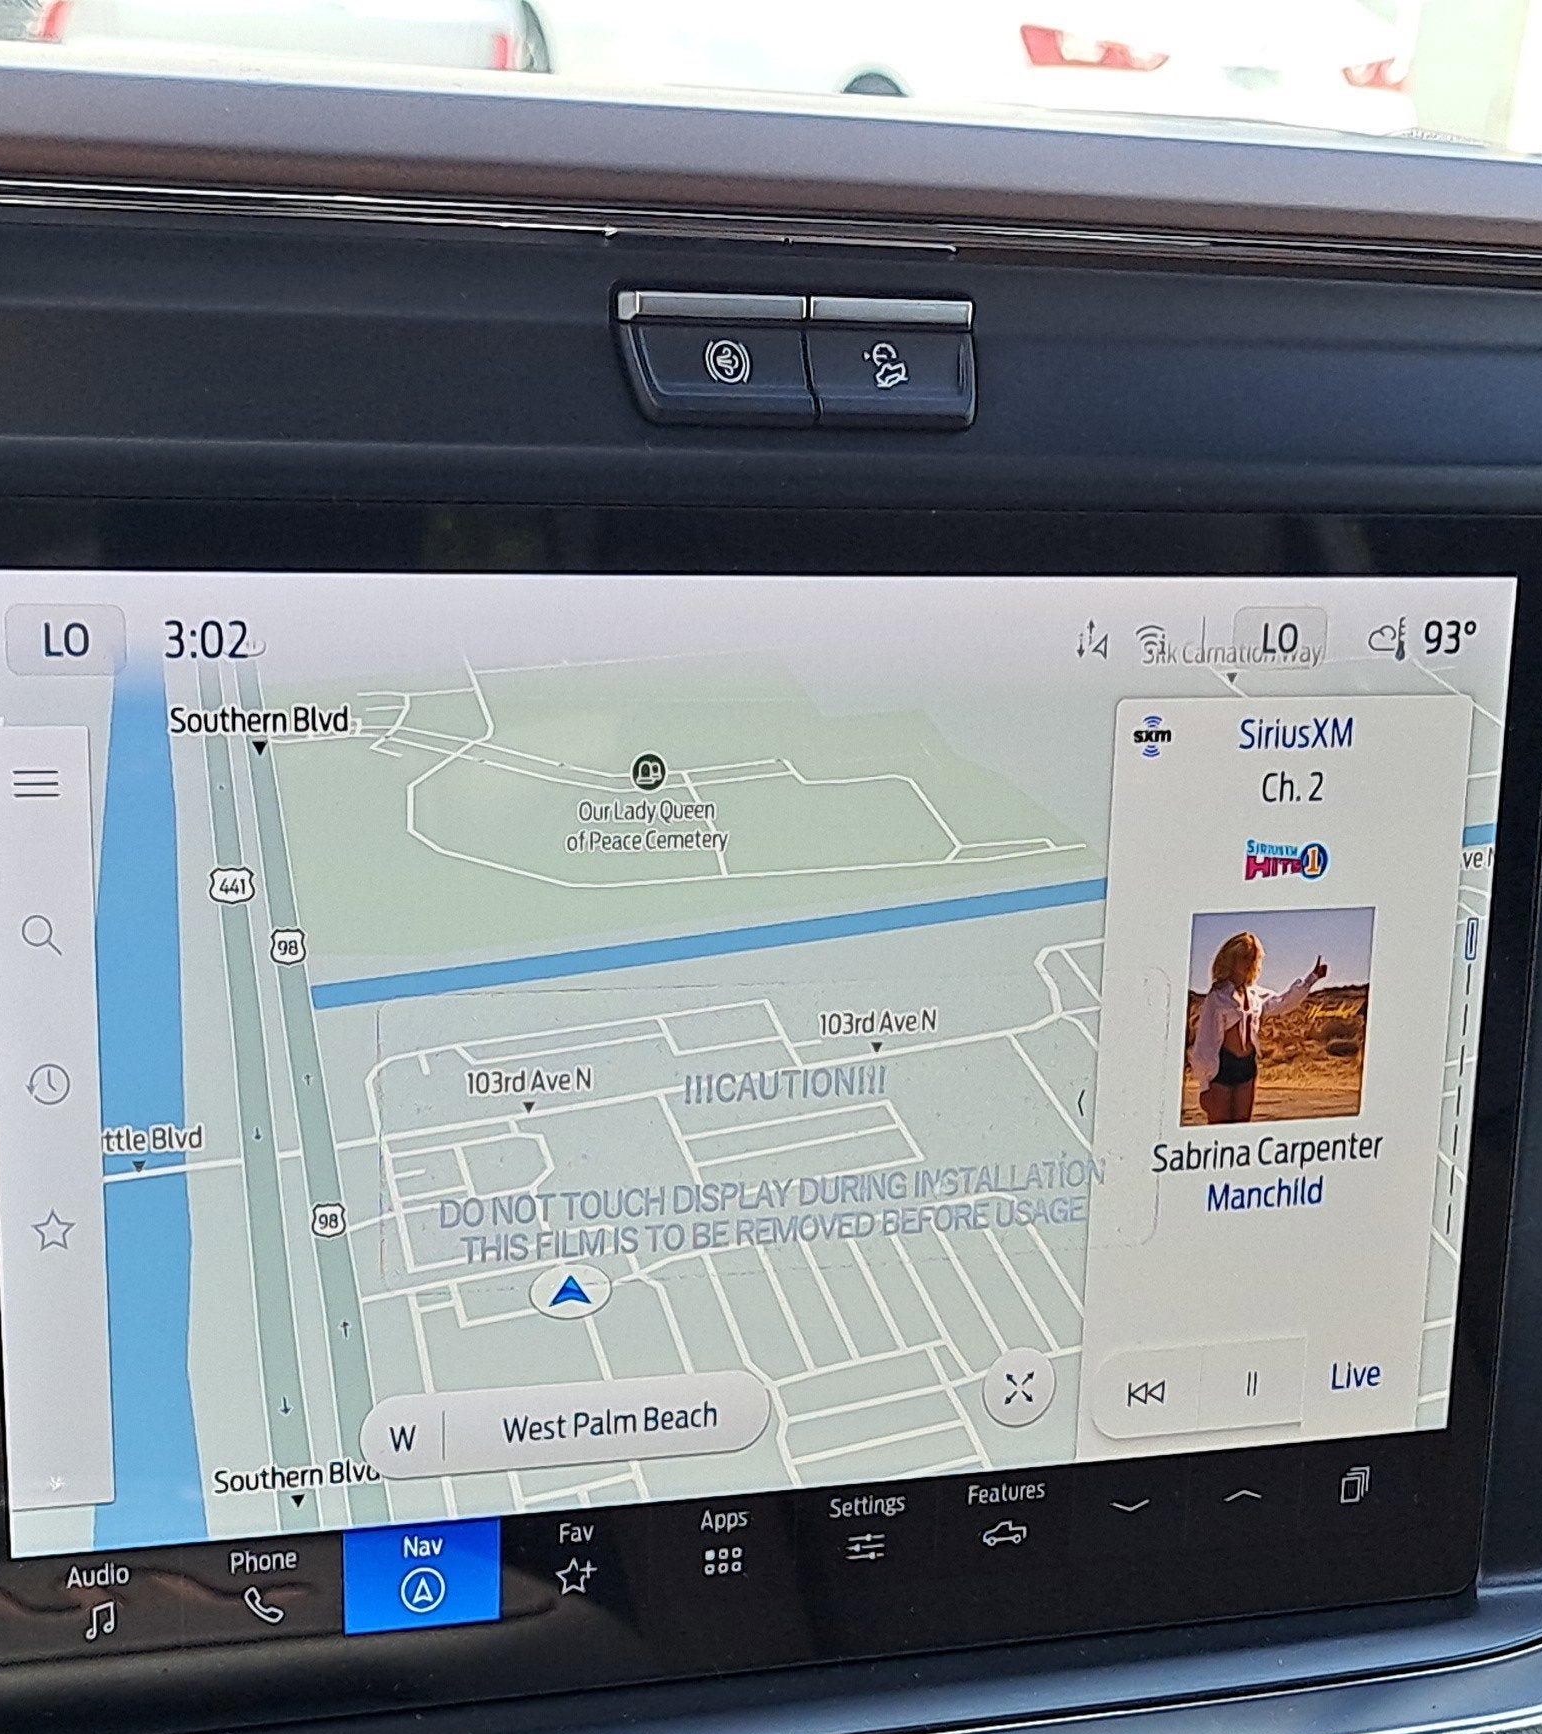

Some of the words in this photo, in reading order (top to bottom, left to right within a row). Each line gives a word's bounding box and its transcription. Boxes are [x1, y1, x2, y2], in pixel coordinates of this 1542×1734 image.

[43, 622, 90, 658] LO
[164, 620, 249, 659] 3:02
[1262, 622, 1299, 655] LO
[1424, 620, 1477, 655] 93°
[170, 707, 287, 734] Southern
[293, 705, 349, 732] Blvd
[1239, 717, 1354, 750] SiriusXM
[1262, 771, 1301, 803] Ch.
[1308, 771, 1324, 801] 2
[578, 801, 609, 822] Our
[614, 800, 657, 824] Lady
[659, 799, 715, 824] Queen
[566, 831, 586, 852] of
[589, 831, 642, 851] Peace
[645, 830, 729, 852] Cemetery
[1460, 850, 1484, 870] ve
[219, 876, 247, 896] 441
[277, 938, 299, 958] 98
[820, 1011, 875, 1036] 103rd
[879, 1011, 917, 1034] Ave
[921, 1009, 937, 1031] N
[467, 1069, 526, 1095] 103rd
[530, 1069, 571, 1092] Ave
[576, 1067, 591, 1090] N
[152, 1125, 202, 1150] Blvd
[1151, 1136, 1251, 1173] Sabrina
[1258, 1133, 1384, 1169] Carpenter
[439, 1199, 484, 1229] DO
[492, 1192, 555, 1227] NOT
[560, 1186, 665, 1221] TOUCH
[672, 1178, 794, 1215] DISPLAY
[799, 1170, 907, 1206] DURING
[914, 1158, 1105, 1198] INSTALLATION
[1206, 1175, 1324, 1213] Manchild
[317, 1213, 339, 1230] 98
[460, 1232, 530, 1265] THIS
[536, 1229, 606, 1260] FILM
[613, 1225, 639, 1255] IS
[645, 1223, 686, 1252] TO
[692, 1219, 731, 1250] BE
[735, 1212, 876, 1247] REMOVED
[882, 1201, 990, 1237] BEFORE
[995, 1195, 1088, 1228] USAGE
[1330, 1362, 1381, 1391] Live
[504, 1415, 568, 1443] West
[573, 1408, 641, 1438] Palm
[643, 1401, 718, 1433] Beach
[390, 1424, 417, 1453] W
[214, 1465, 323, 1494] Southern
[967, 1478, 1046, 1505] Features
[829, 1493, 906, 1520] Settings
[558, 1522, 595, 1546] Fav
[700, 1509, 750, 1534] Apps
[402, 1534, 444, 1559] Nav
[66, 1563, 131, 1589] Audio
[229, 1549, 297, 1576] Phone
